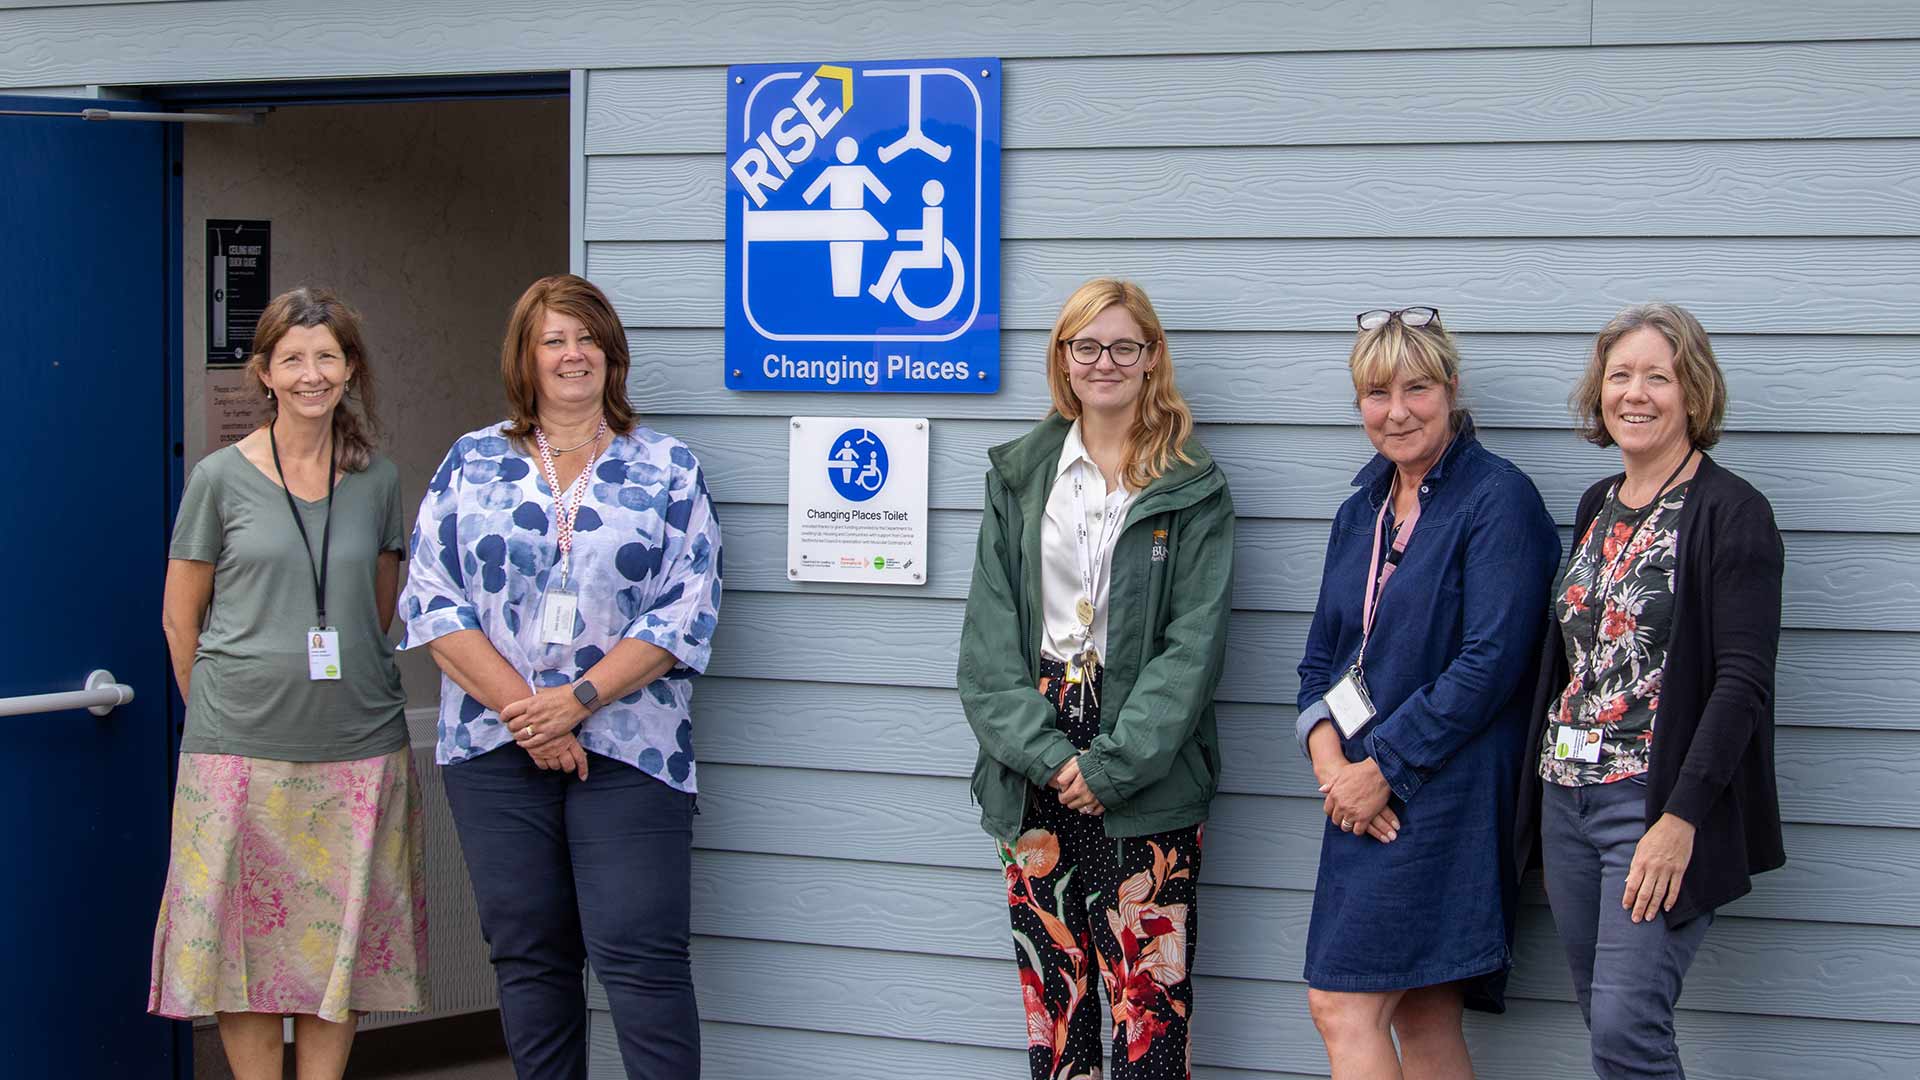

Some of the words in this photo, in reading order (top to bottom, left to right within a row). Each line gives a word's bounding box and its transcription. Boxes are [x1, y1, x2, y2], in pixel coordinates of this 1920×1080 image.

[730, 75, 844, 208] RISE
[762, 354, 879, 385] Changing
[887, 355, 970, 380] Places
[807, 509, 850, 522] Changing
[852, 510, 881, 521] Places
[883, 511, 908, 521] Toilet
